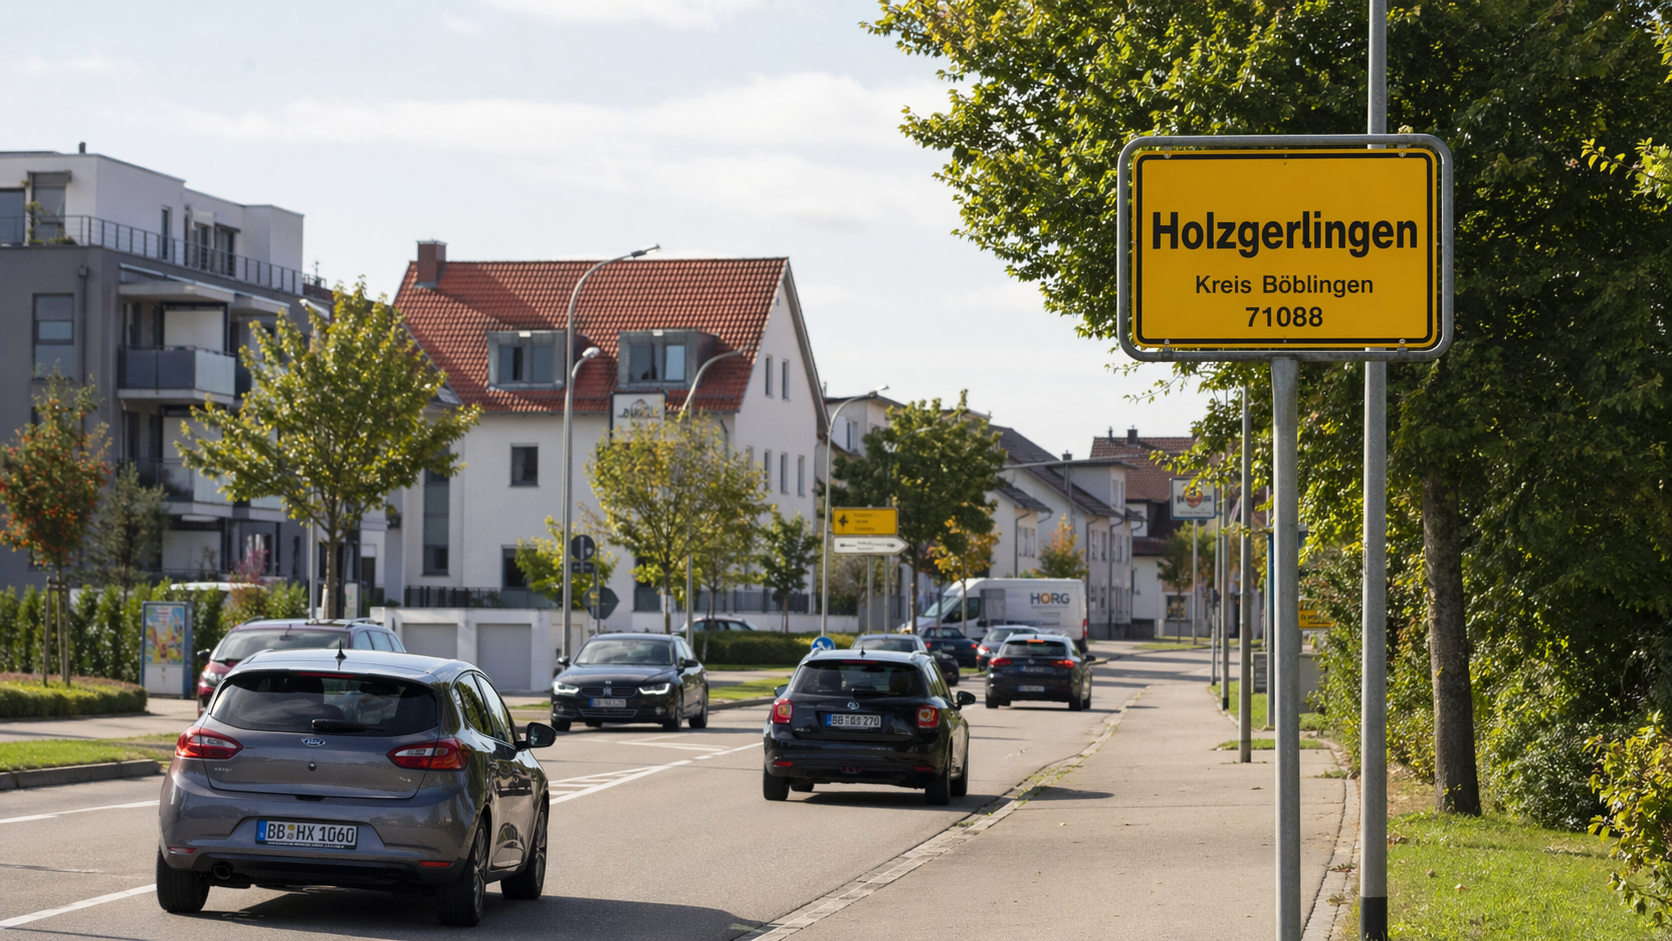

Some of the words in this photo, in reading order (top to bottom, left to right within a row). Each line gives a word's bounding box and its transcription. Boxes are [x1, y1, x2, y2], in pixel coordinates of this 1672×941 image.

[1152, 211, 1418, 258] Holzgerlingen
[1195, 275, 1252, 294] Kreis
[1262, 274, 1374, 298] Böblingen
[1245, 306, 1323, 327] 71088
[1030, 592, 1070, 605] HORG
[267, 823, 286, 840] BB
[296, 825, 316, 841] HX
[318, 826, 355, 843] 1060
